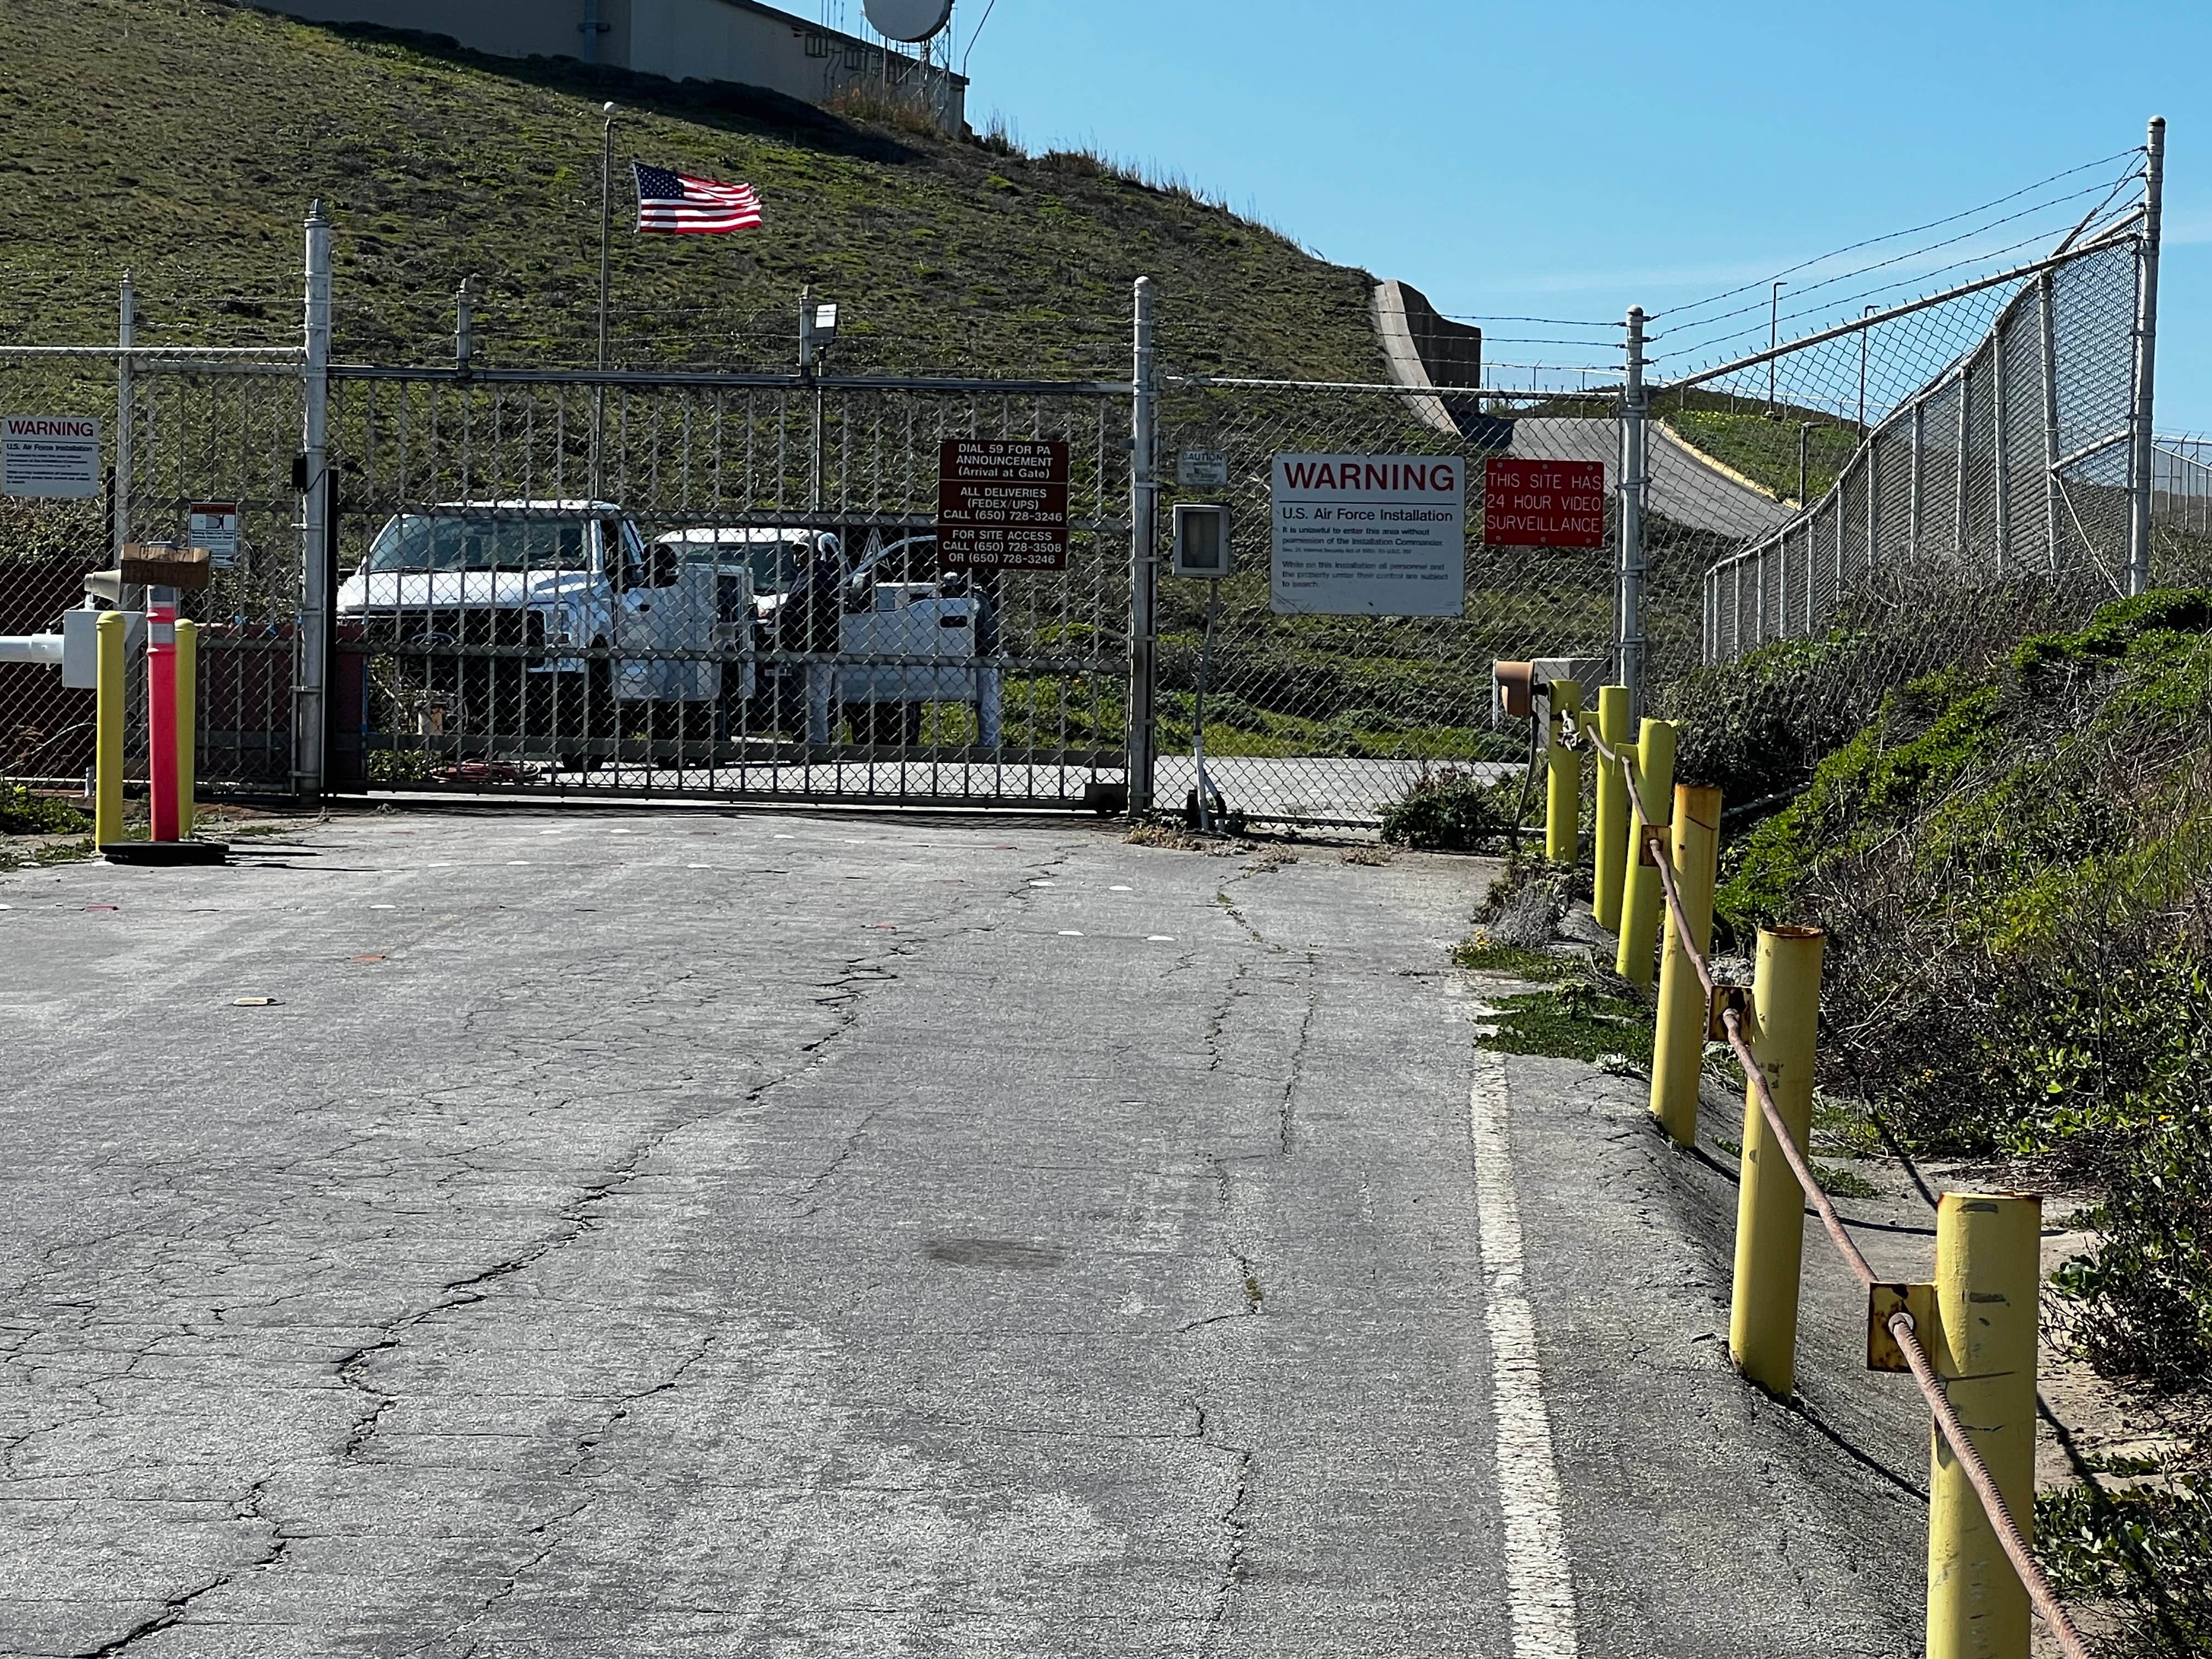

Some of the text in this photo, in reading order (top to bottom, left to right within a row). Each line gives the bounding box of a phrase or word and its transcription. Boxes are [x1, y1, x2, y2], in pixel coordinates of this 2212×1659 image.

[8, 420, 93, 436] WARNING
[959, 444, 1050, 455] DIAL 59 FOR PA
[956, 455, 1053, 466] ANNOUNCEMENT
[958, 466, 1049, 479] (Arrival at Gate)
[1284, 462, 1454, 490] WARNING
[1488, 473, 1601, 490] THIS SITE HAS
[961, 487, 1046, 498] ALL DELIVERIES
[968, 498, 1039, 510] (FEDEX/UPS)
[1487, 494, 1601, 511] 24 HOUR VIDEO
[944, 510, 1062, 521] CALL (650) 728-3246
[1283, 507, 1452, 521] U.S. Air Force Installation
[1487, 515, 1600, 533] SURVEILLANCE
[952, 530, 1052, 540] FOR SITE ACCESS
[943, 541, 1062, 552] CALL (650) 728-3508
[949, 553, 1055, 563] OR (650) 728-3246
